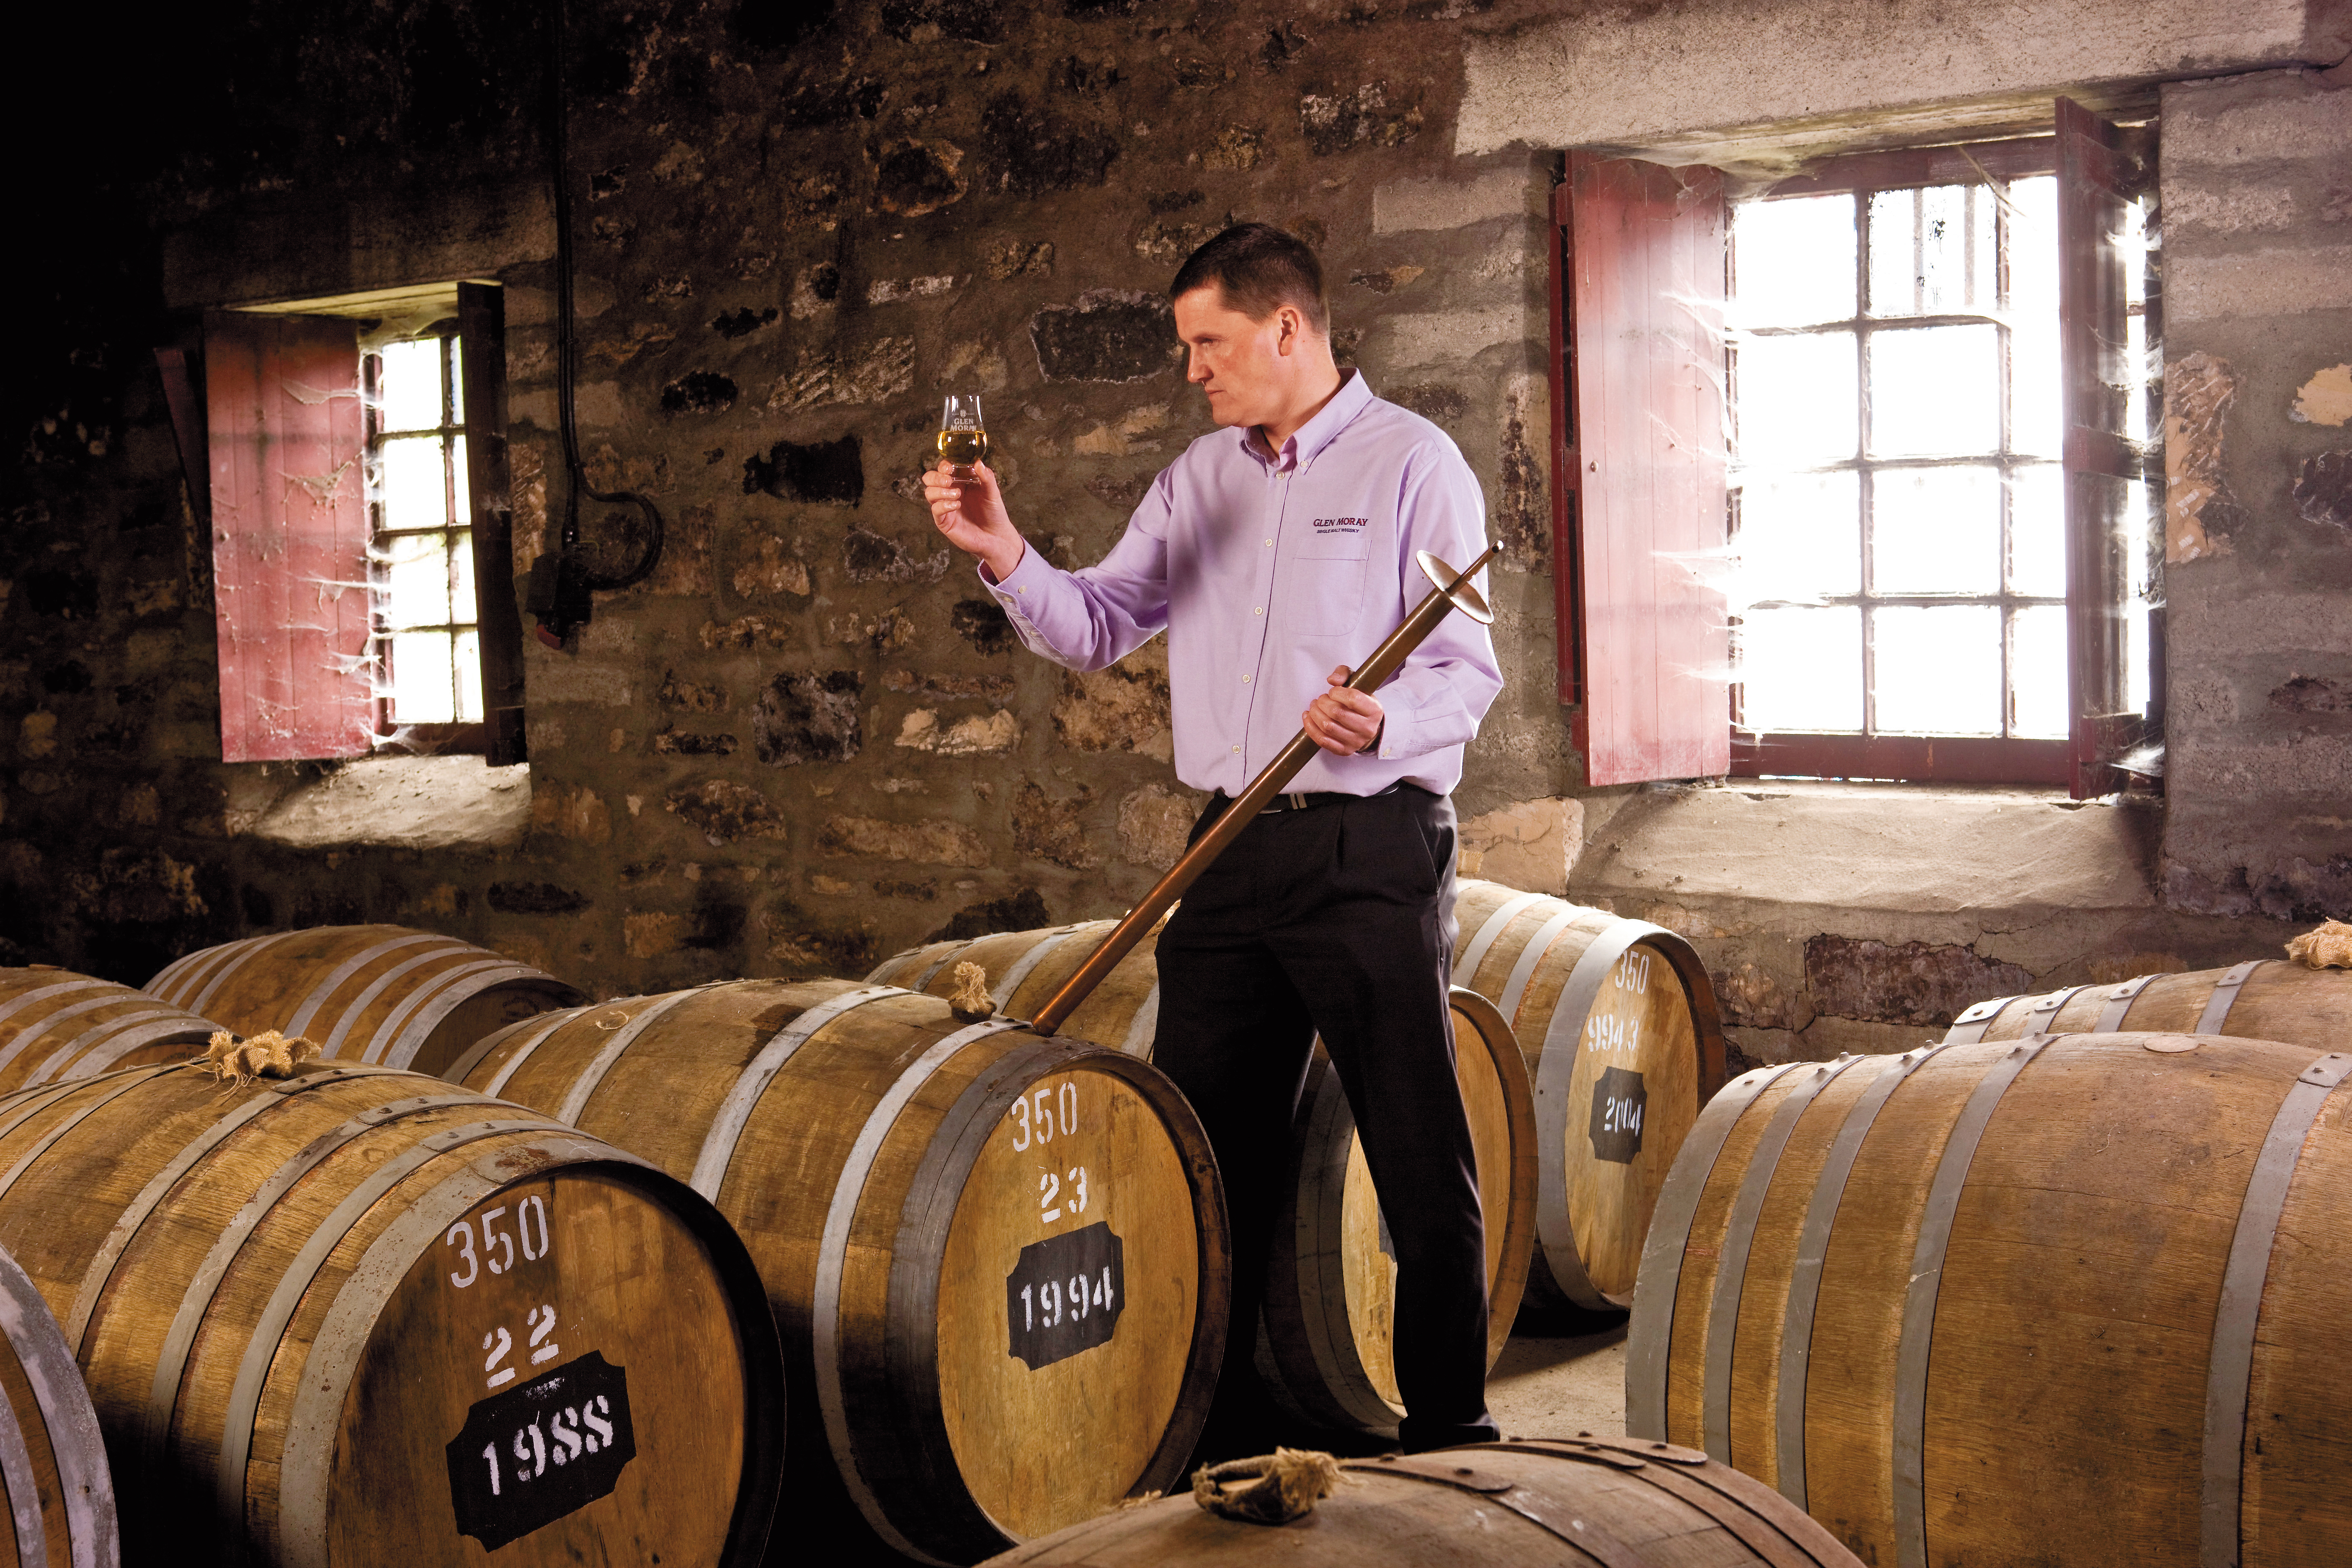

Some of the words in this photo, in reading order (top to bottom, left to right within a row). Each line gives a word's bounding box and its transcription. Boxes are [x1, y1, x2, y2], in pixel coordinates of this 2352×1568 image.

[1336, 518, 1369, 526] MORAY
[1615, 950, 1649, 995] 350
[1011, 1081, 1078, 1153] 350
[1604, 1096, 1641, 1137] 2004
[1040, 1166, 1087, 1223] 23
[447, 1195, 549, 1288] 350
[1021, 1266, 1114, 1333] 1994
[482, 1304, 559, 1390] 22
[483, 1395, 614, 1495] 1988
